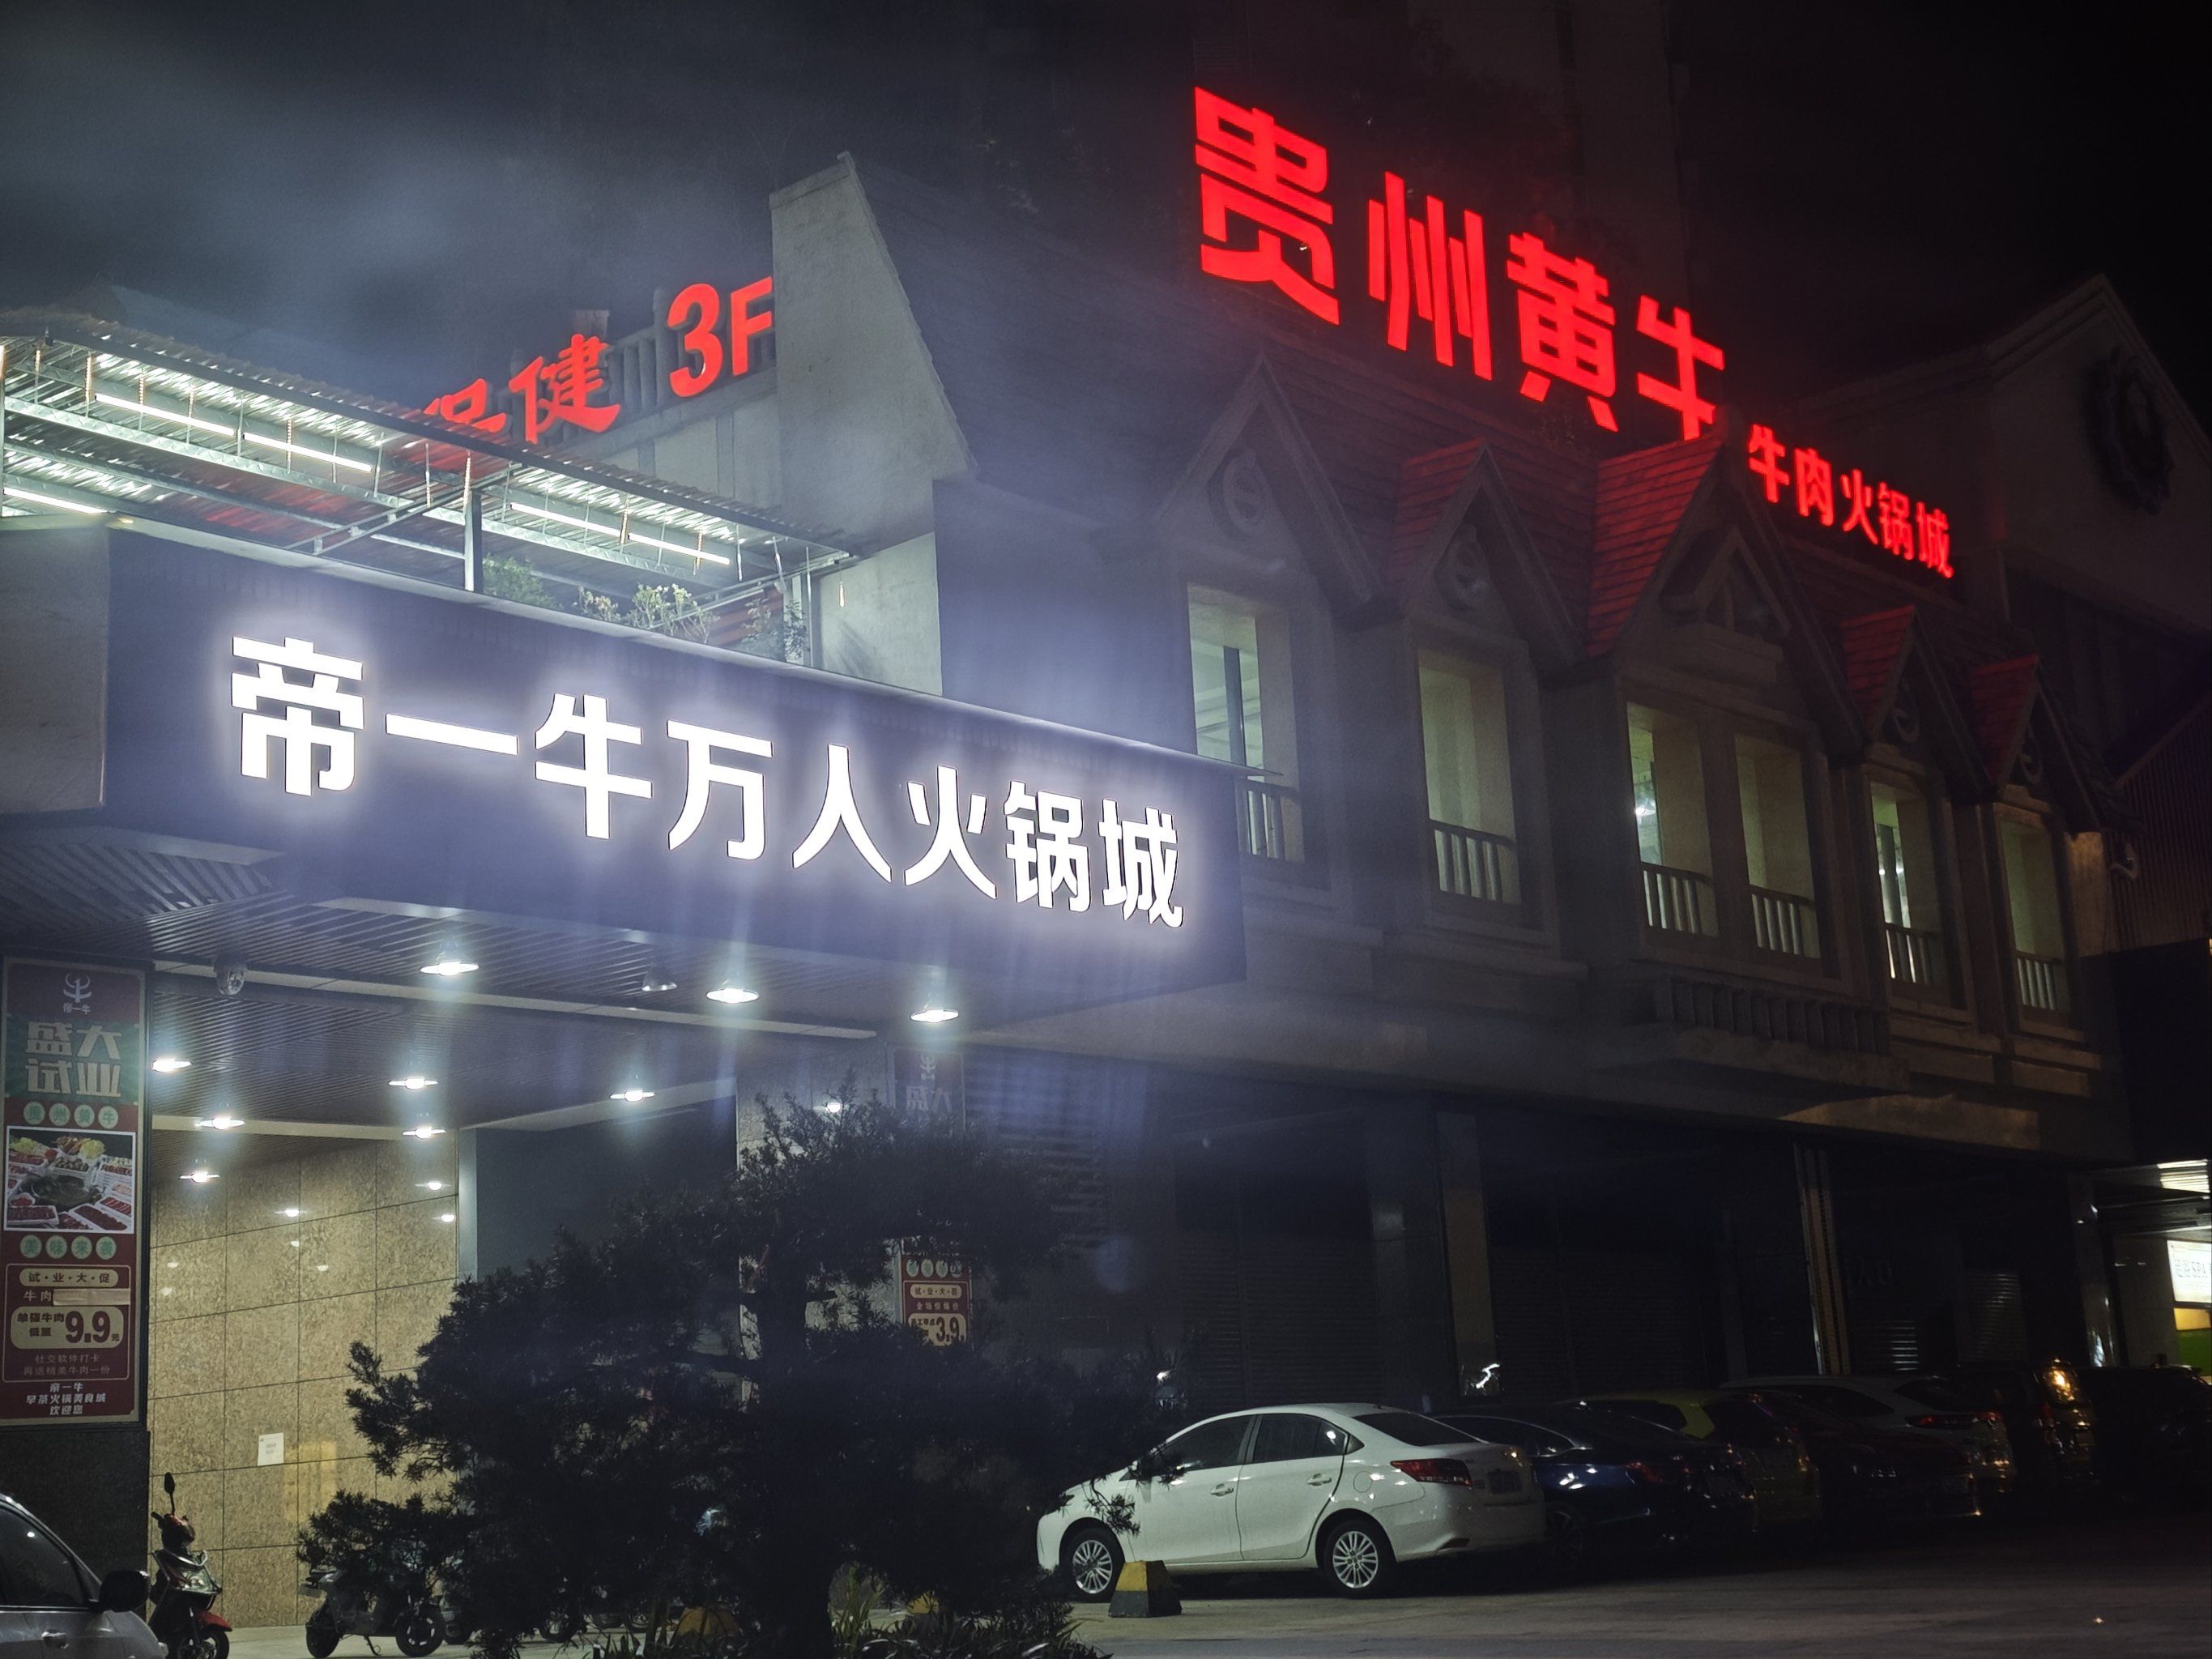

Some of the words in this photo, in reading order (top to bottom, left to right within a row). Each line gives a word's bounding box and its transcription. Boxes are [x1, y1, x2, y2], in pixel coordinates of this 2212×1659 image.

[1196, 88, 1724, 441] 贵州黄牛
[668, 278, 772, 396] 3F
[1749, 425, 1952, 578] 牛肉火锅城
[232, 638, 1182, 927] 帝一牛万人火锅城
[25, 1021, 122, 1060] 盛大
[25, 1058, 121, 1098] 试业
